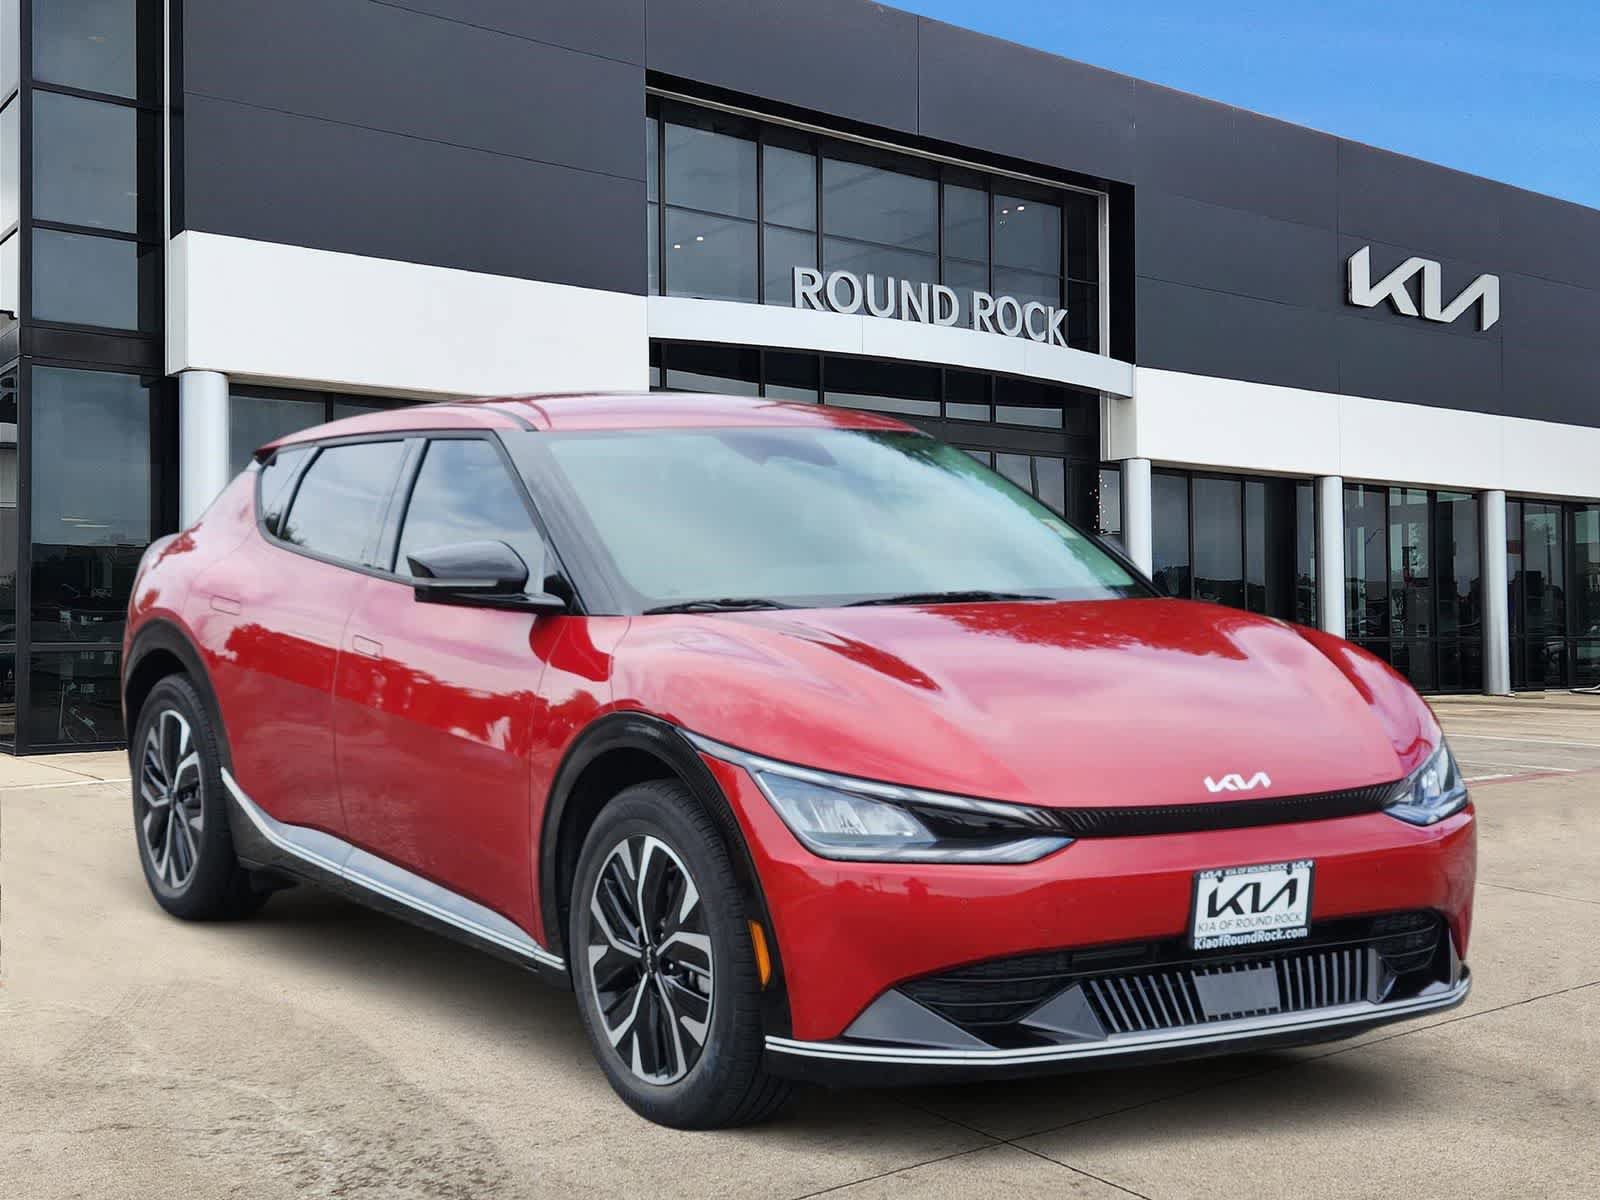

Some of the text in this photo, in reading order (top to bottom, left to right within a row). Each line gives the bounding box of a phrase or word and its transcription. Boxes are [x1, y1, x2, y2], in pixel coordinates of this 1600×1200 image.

[1348, 245, 1500, 331] KIA
[793, 266, 1069, 348] ROUND ROCK
[1203, 771, 1272, 793] KIA
[1207, 878, 1298, 918] KIA
[1198, 912, 1303, 933] KIA OF ROUND ROCK
[1194, 927, 1308, 950] KiaofRoundRock.com
